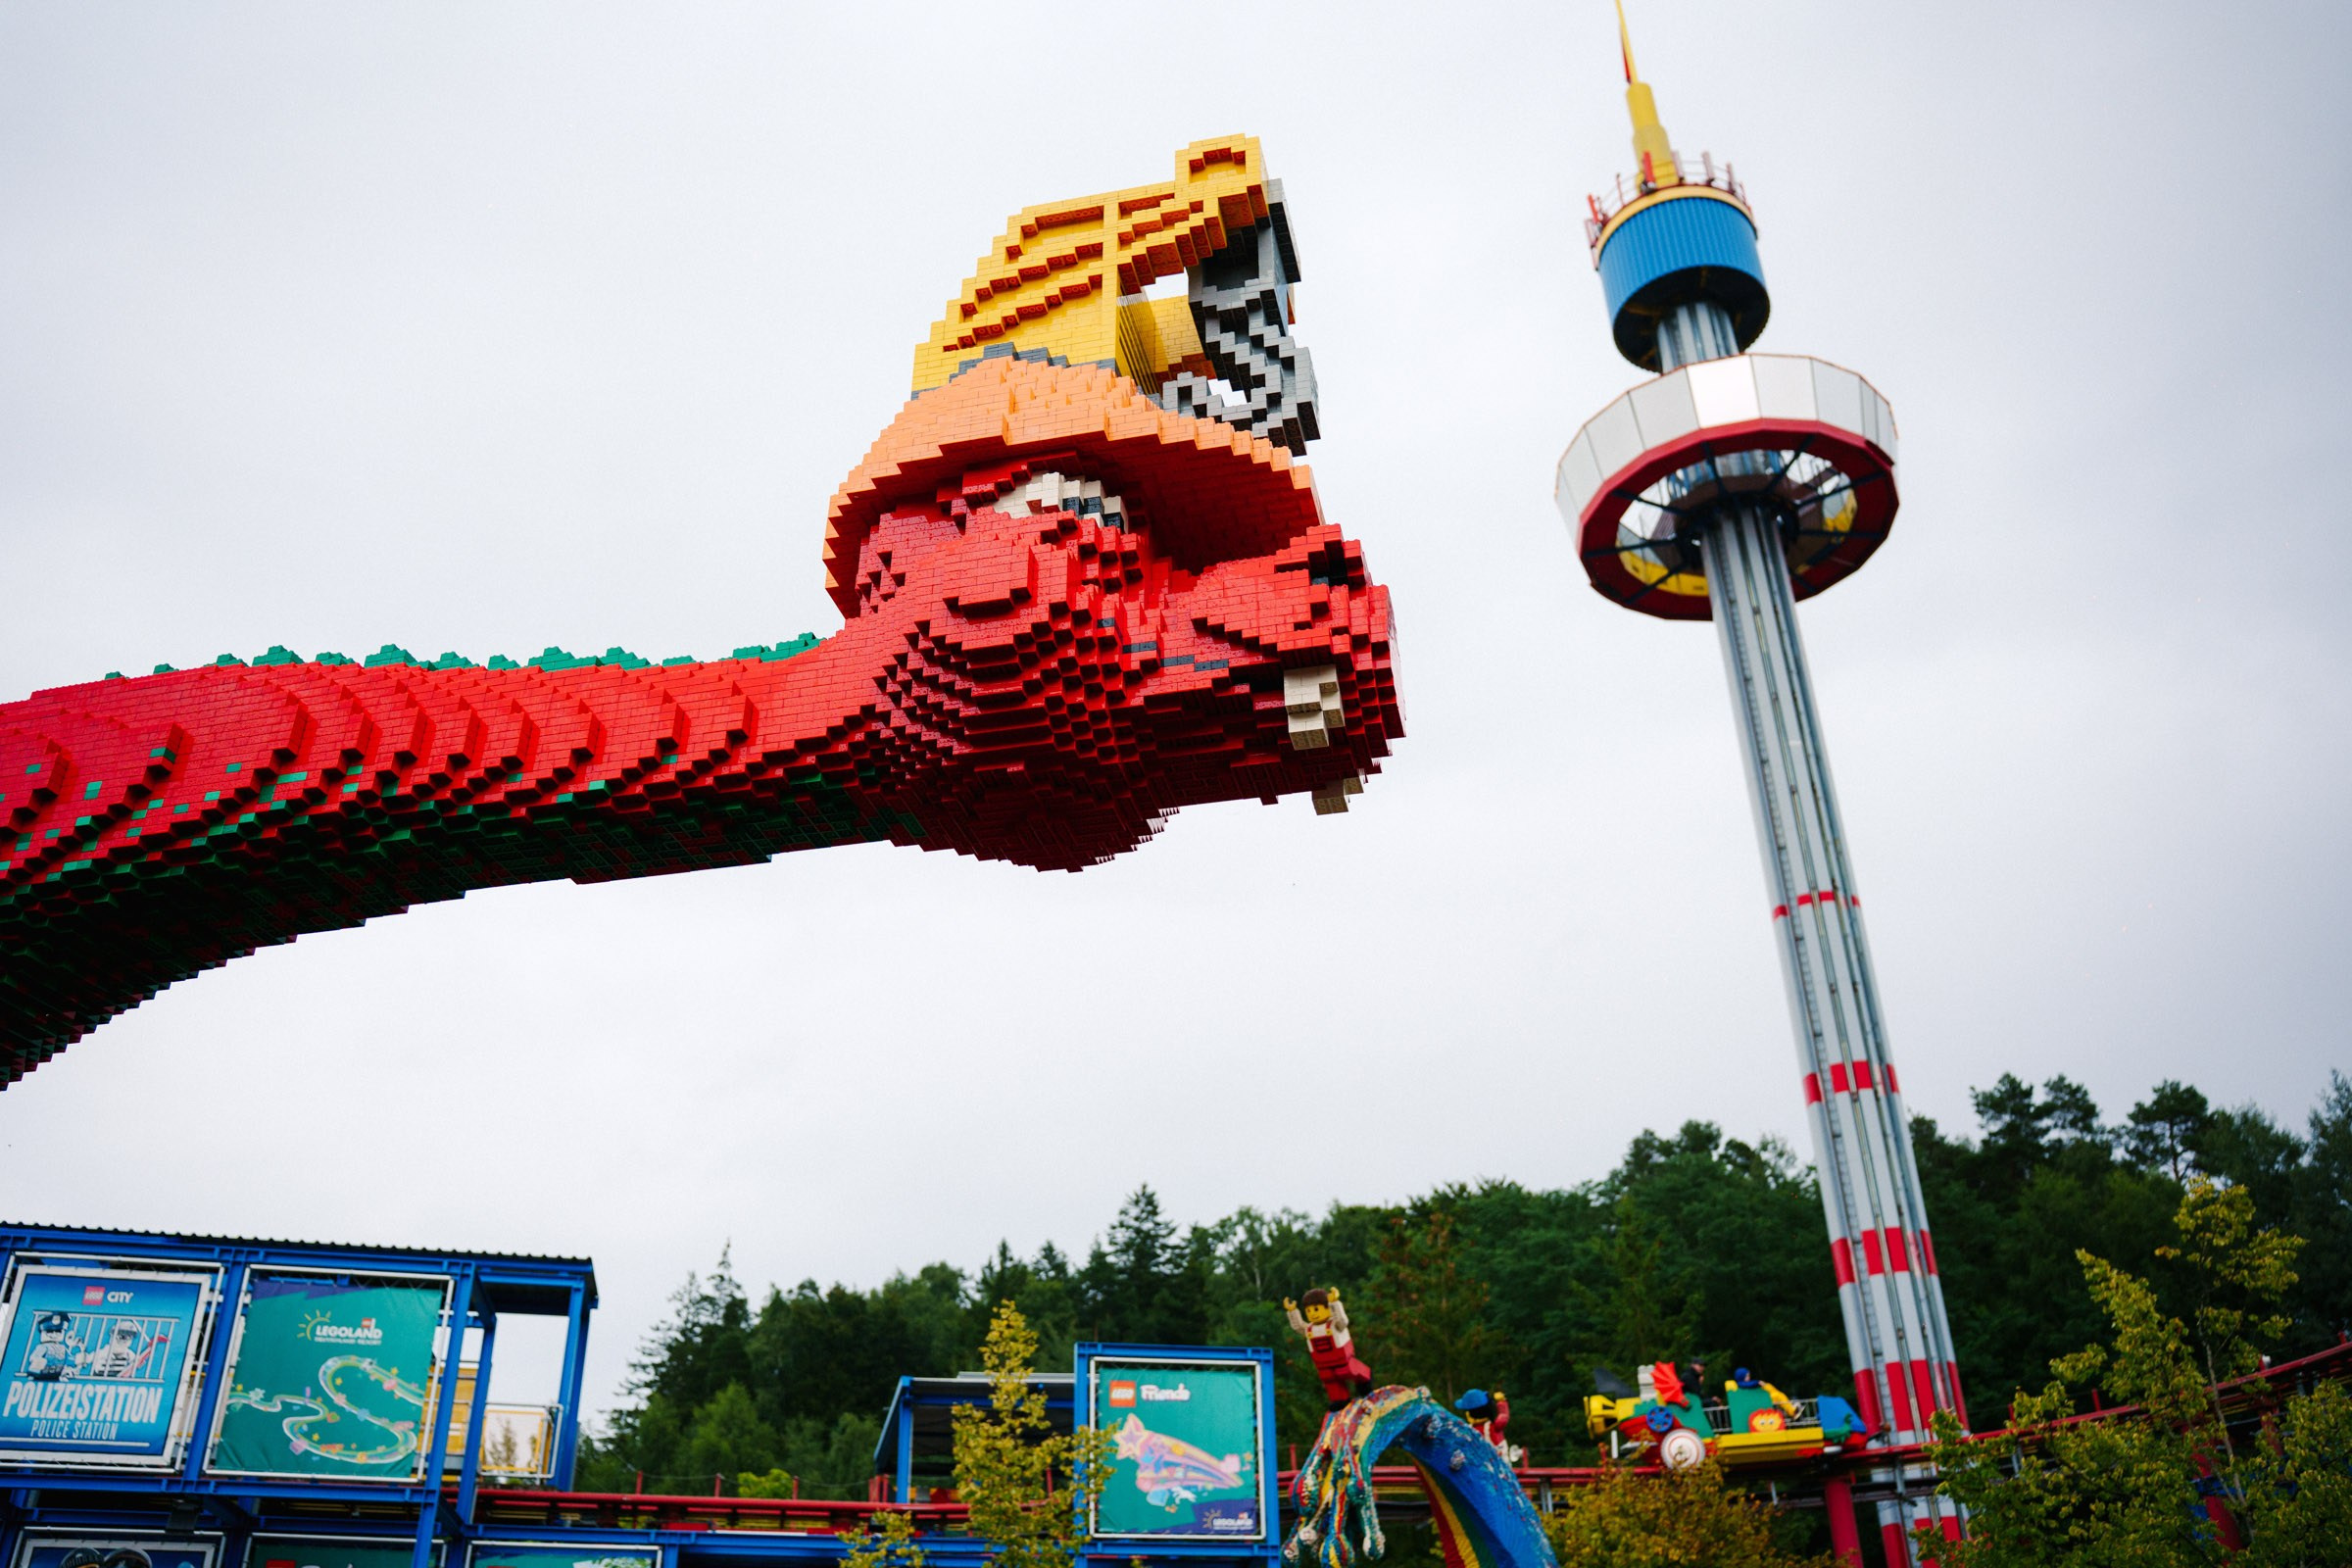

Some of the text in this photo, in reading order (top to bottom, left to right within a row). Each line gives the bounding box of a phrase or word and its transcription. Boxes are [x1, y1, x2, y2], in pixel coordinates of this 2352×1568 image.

[107, 1291, 134, 1303] CITY
[316, 1320, 382, 1339] LEGOLAND
[3, 1381, 164, 1424] POLIZEISTATION
[30, 1420, 119, 1440] POLICE STATION
